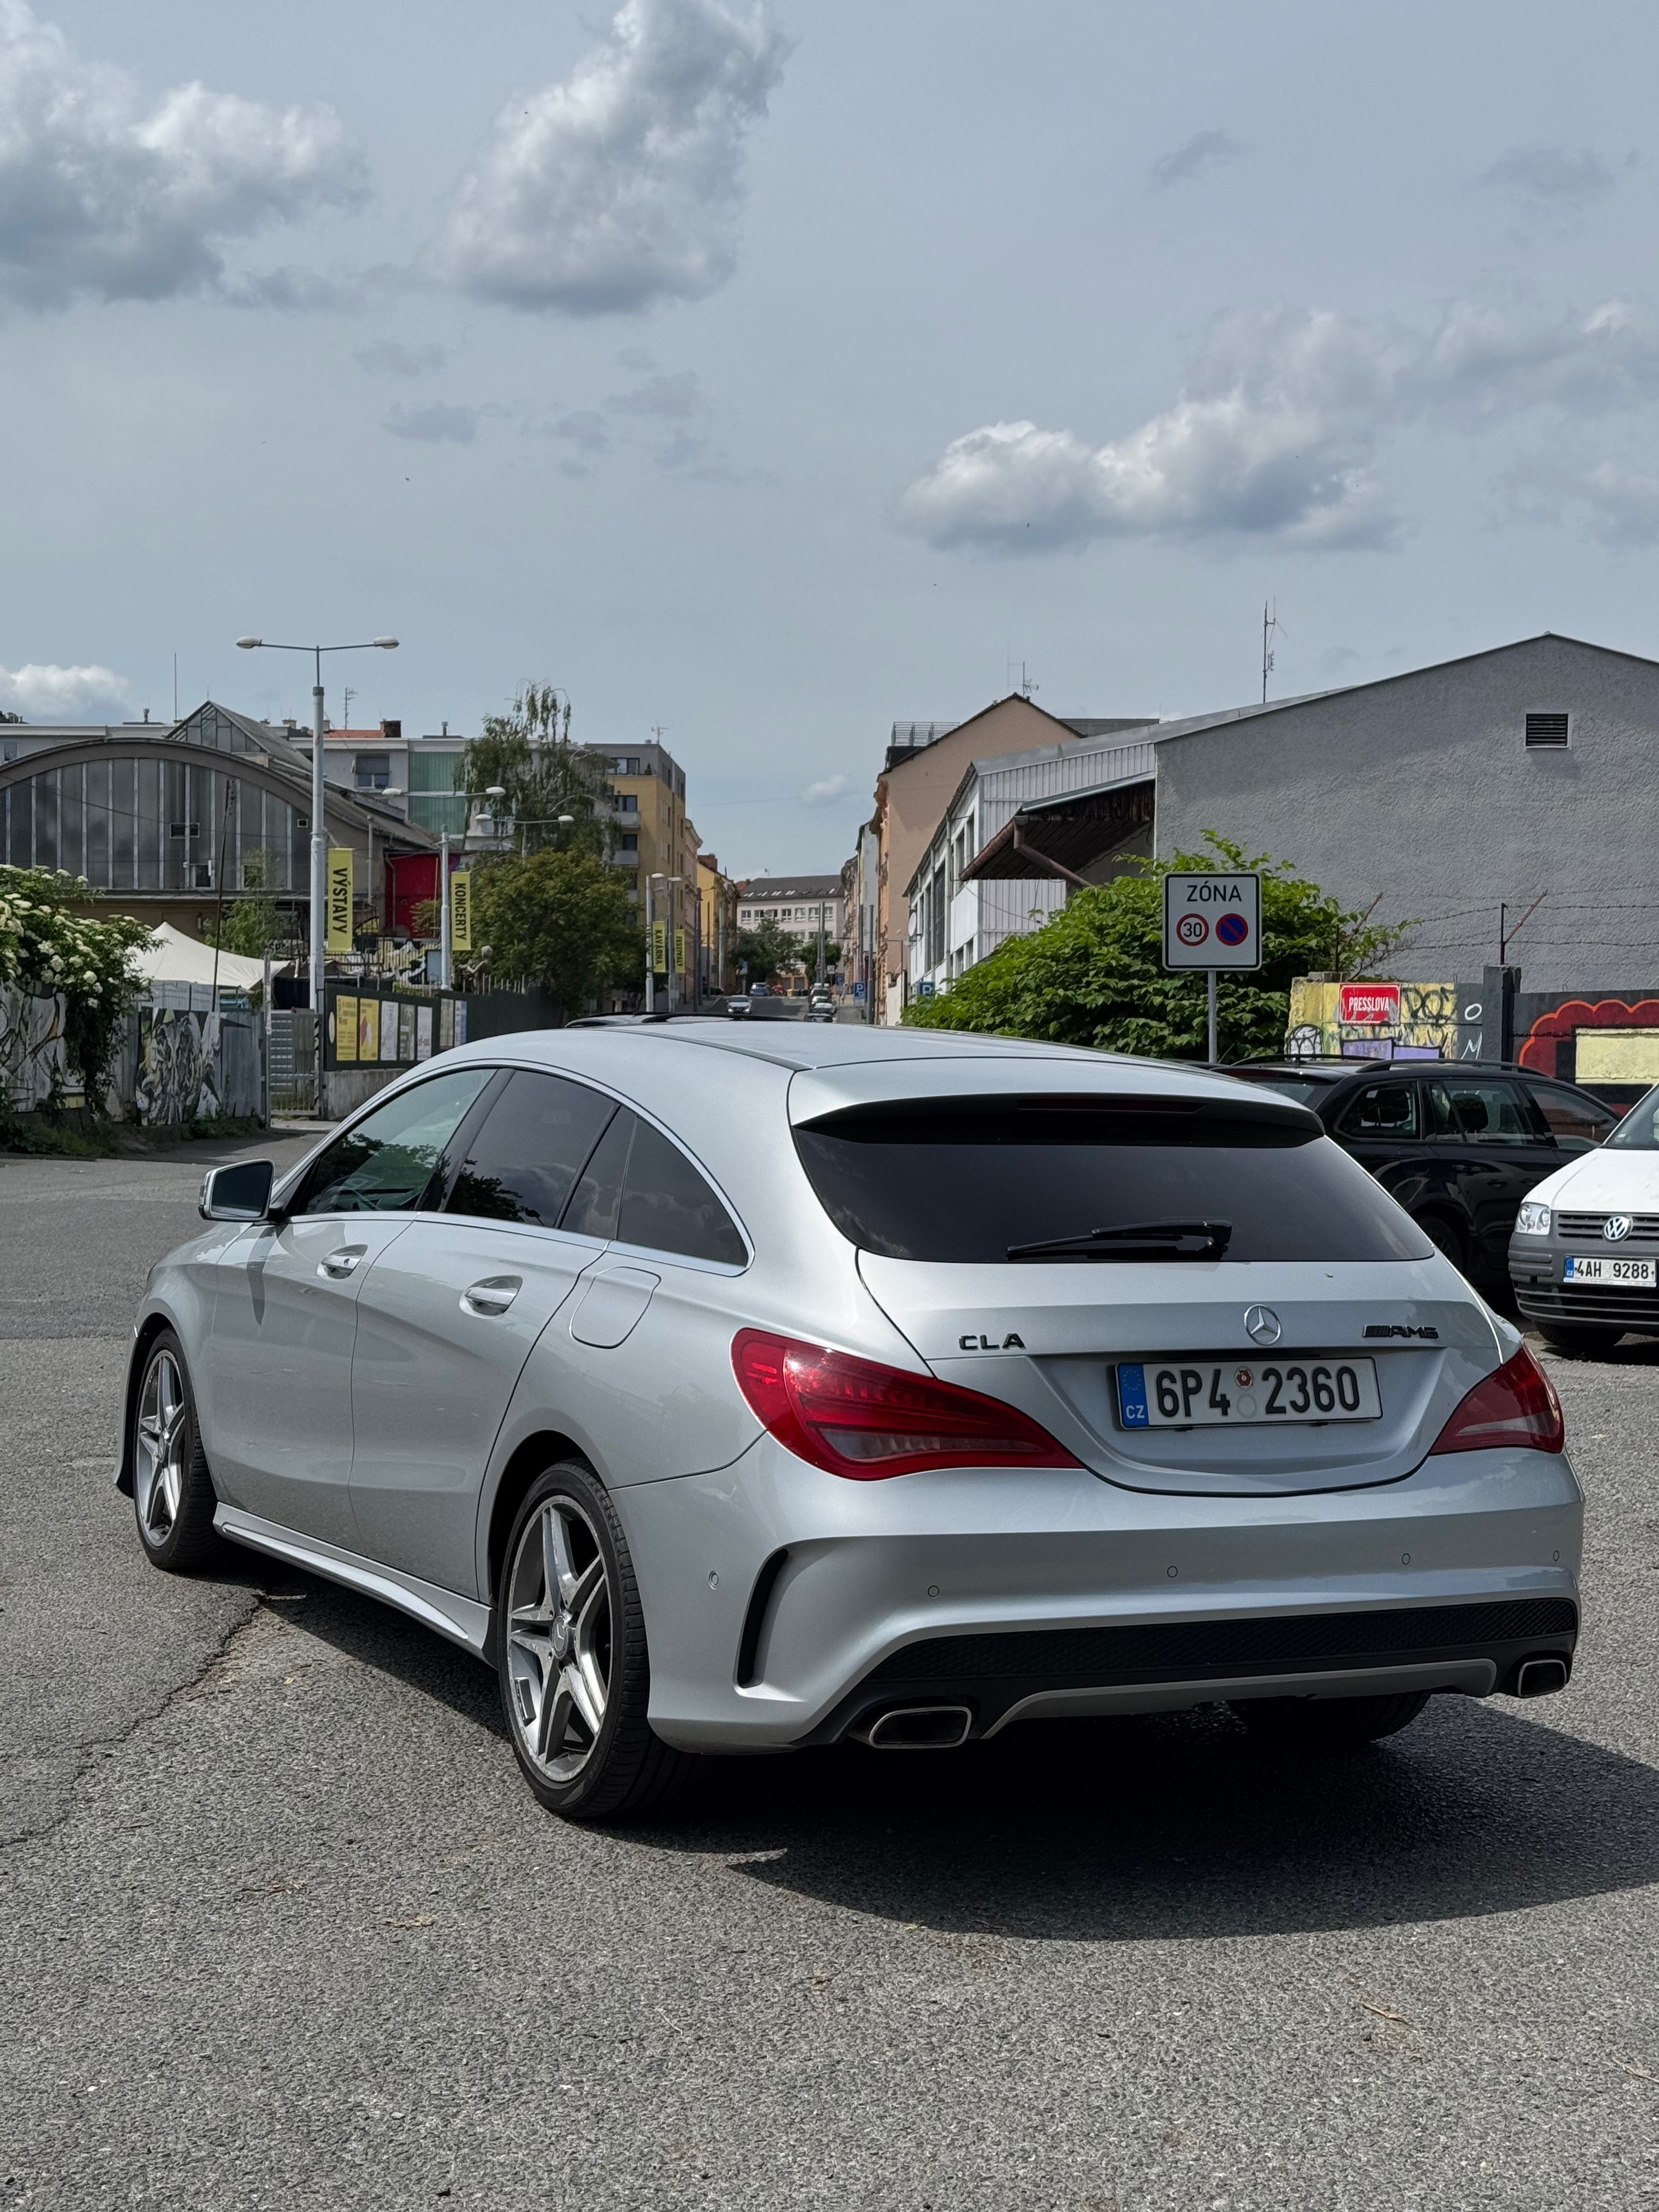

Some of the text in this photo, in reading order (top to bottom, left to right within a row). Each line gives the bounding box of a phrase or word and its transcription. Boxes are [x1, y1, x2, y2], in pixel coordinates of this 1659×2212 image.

[332, 867, 351, 934] VÝSTAVY
[1187, 881, 1242, 902] ZÓNA
[455, 883, 466, 940] KONCERTY
[1183, 922, 1202, 937] 30
[1348, 996, 1390, 1012] PRESSLOVA
[1577, 1260, 1649, 1279] 4AH 9288
[1389, 1325, 1440, 1339] AMG
[958, 1333, 1026, 1350] CLA
[1155, 1365, 1360, 1418] 6P4 2360
[1126, 1404, 1145, 1419] CZ
